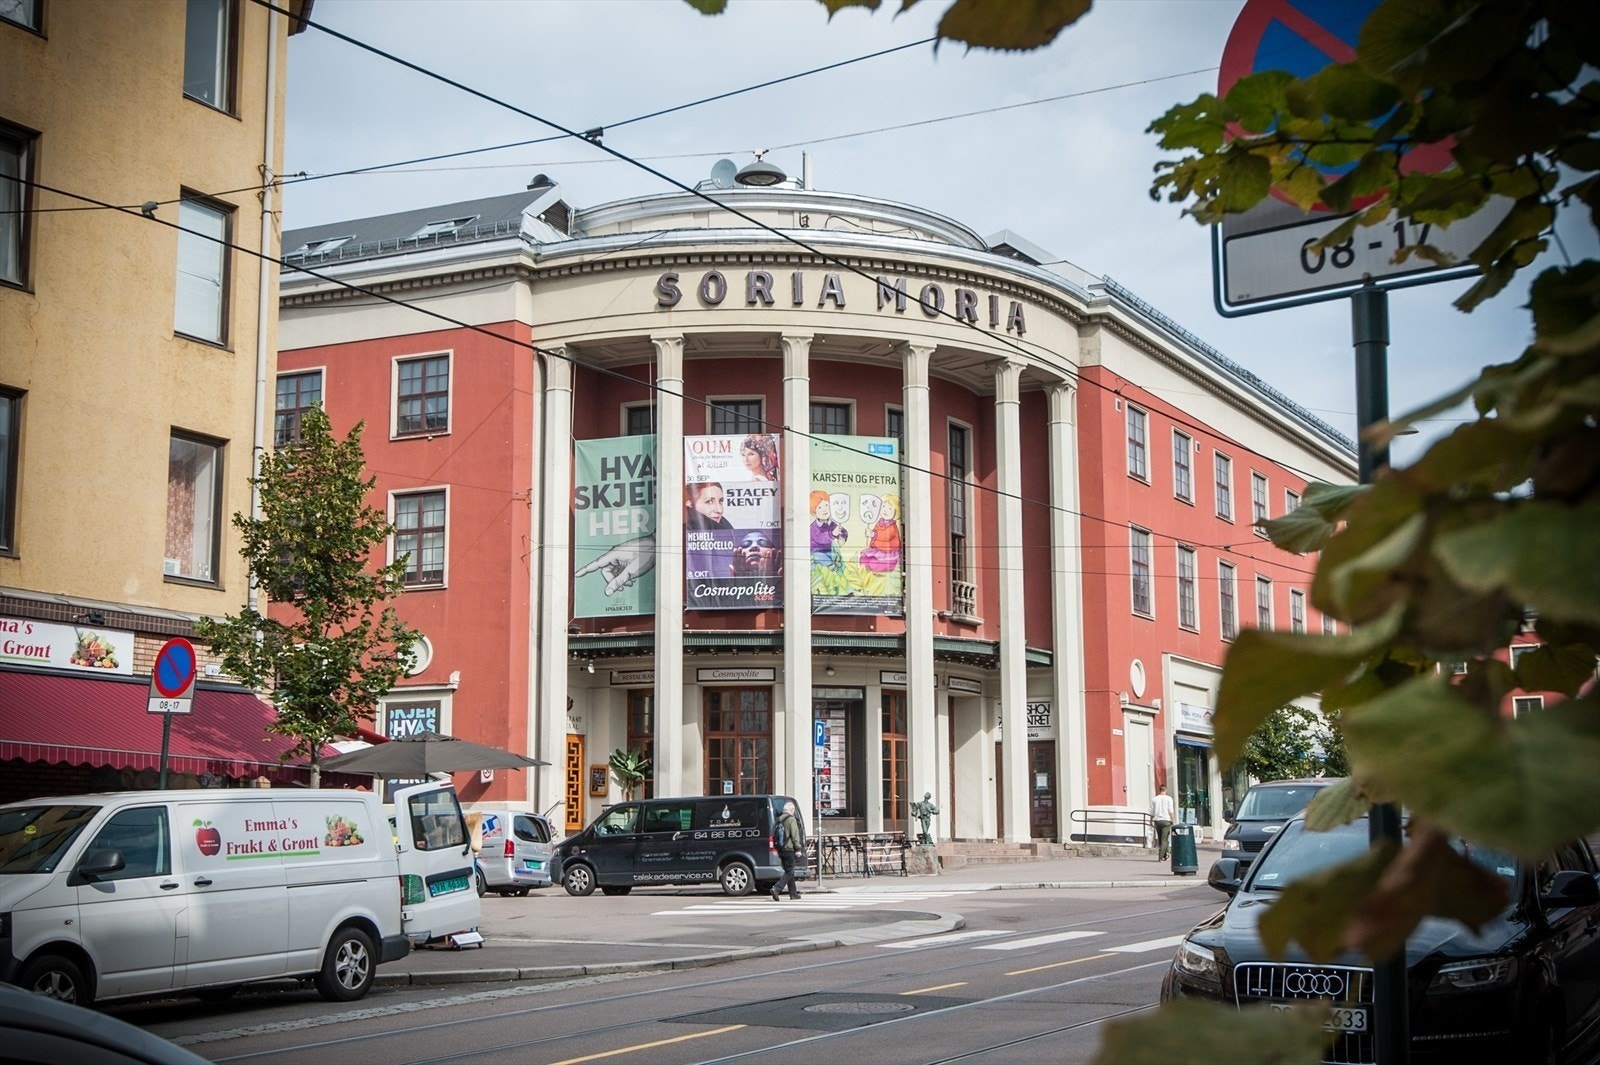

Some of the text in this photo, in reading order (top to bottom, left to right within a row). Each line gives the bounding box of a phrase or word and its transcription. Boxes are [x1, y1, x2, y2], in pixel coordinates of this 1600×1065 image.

[656, 270, 1027, 333] SORIA MORIA
[692, 440, 732, 455] OUM
[600, 454, 657, 481] HVA
[812, 472, 854, 483] KARSTEN
[855, 474, 868, 484] OG
[869, 475, 897, 485] PETRA
[726, 488, 778, 497] STACEY
[727, 498, 762, 507] KENT
[589, 508, 650, 537] HER
[687, 532, 715, 541] MESHELL
[687, 541, 734, 550] NDEGEOCELLO
[694, 581, 776, 600] Cosmopolite
[3, 639, 51, 658] Grønt
[622, 672, 655, 680] RESTAURAN
[712, 669, 760, 679] Cosmopolite
[159, 701, 180, 709] 08-17
[244, 817, 299, 832] Emma's
[694, 831, 708, 839] 64
[728, 830, 742, 838] 80
[745, 829, 760, 837] 00
[226, 839, 264, 855] Frukt
[267, 838, 278, 853] &
[282, 836, 319, 851] Grønt
